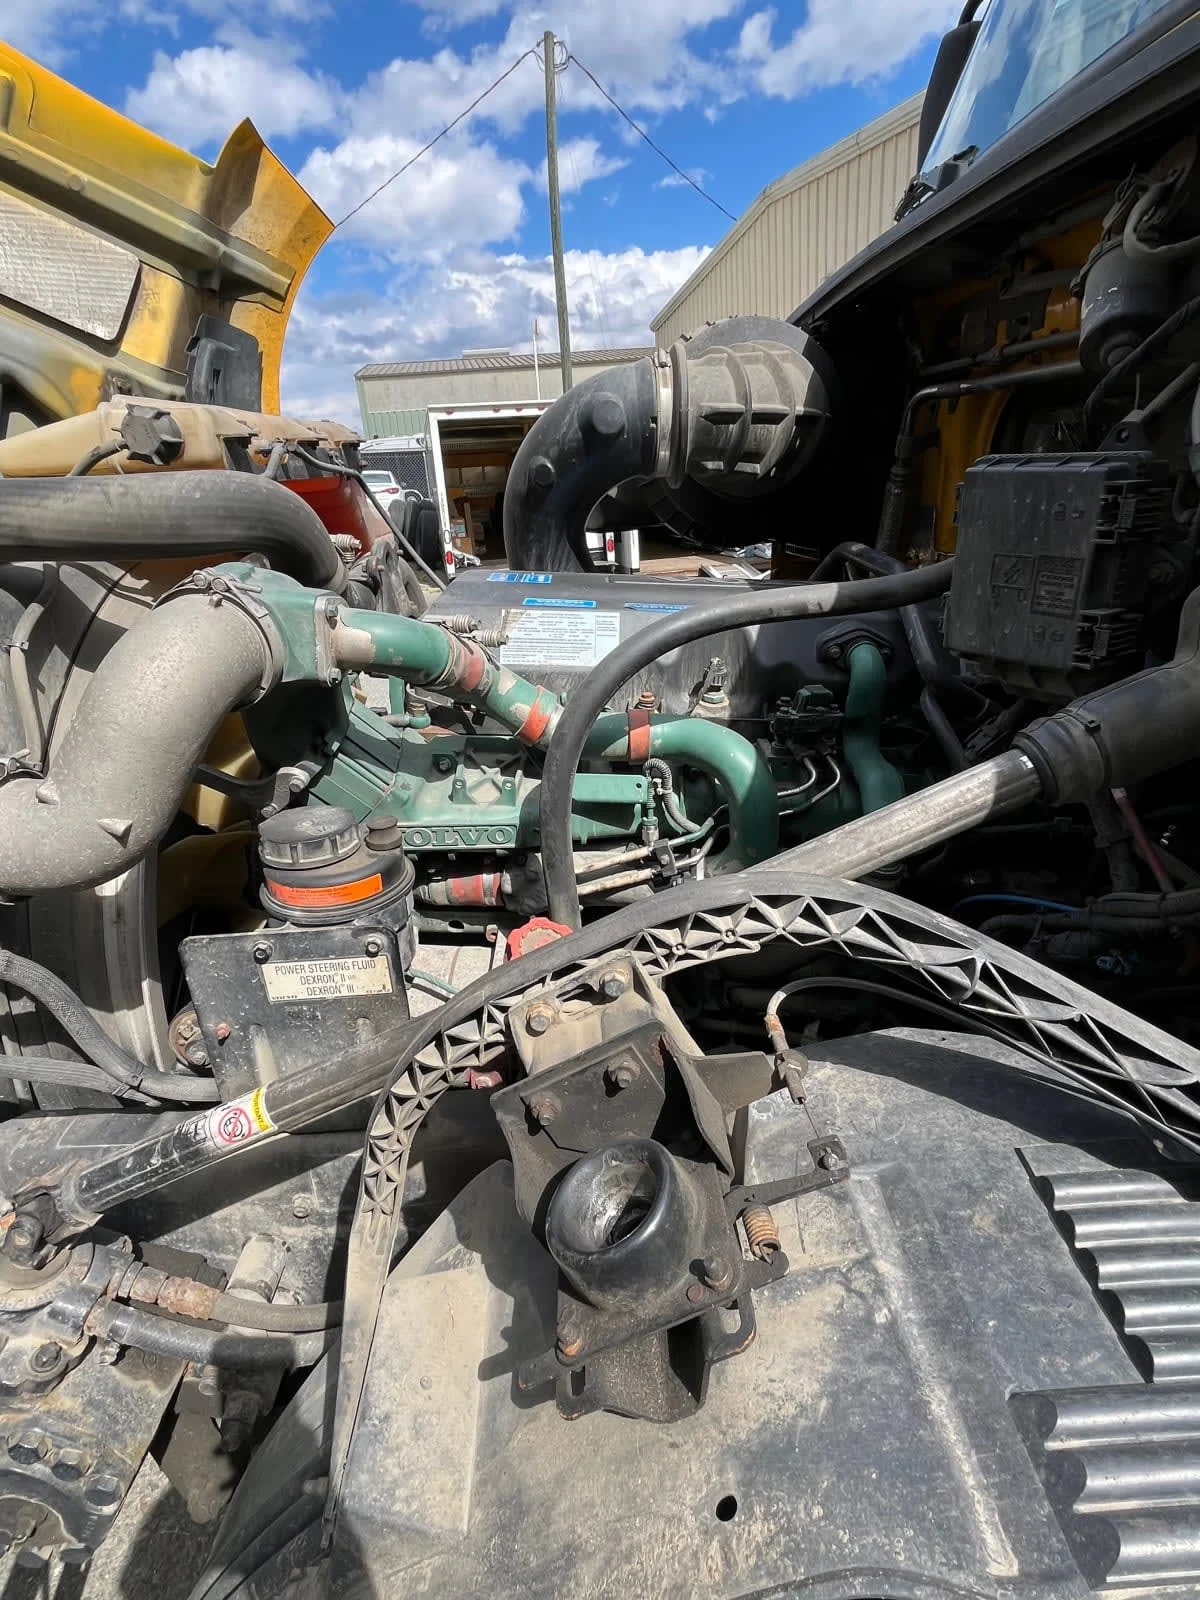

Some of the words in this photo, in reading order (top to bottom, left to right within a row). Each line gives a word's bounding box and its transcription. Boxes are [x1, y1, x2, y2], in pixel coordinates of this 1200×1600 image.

[402, 827, 514, 847] OLVO
[275, 964, 306, 975] POWER
[308, 961, 350, 974] STEERING
[352, 959, 376, 970] FLUID
[346, 984, 355, 993] III
